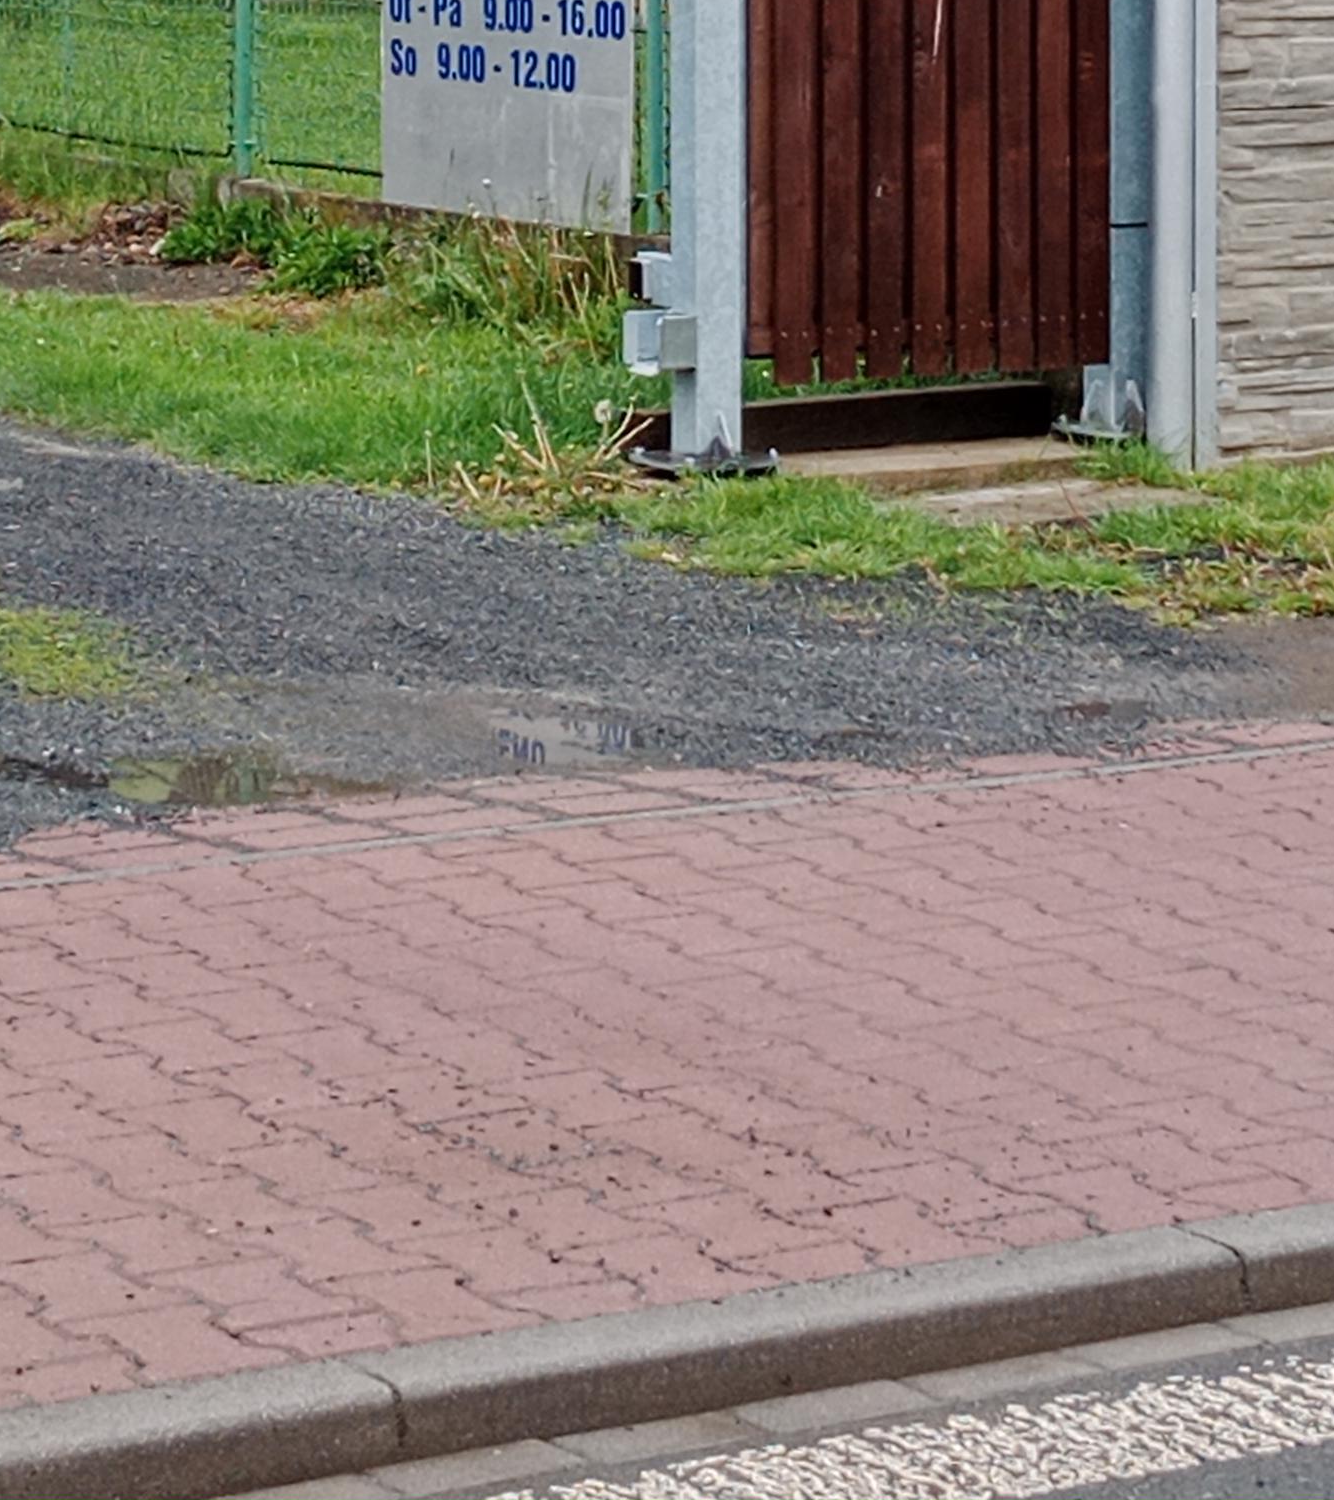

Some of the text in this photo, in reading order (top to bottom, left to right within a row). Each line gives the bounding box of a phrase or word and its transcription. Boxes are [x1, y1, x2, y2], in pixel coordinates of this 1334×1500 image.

[389, 37, 418, 77] So
[437, 41, 486, 84] 9.00
[510, 49, 576, 94] 12.00
